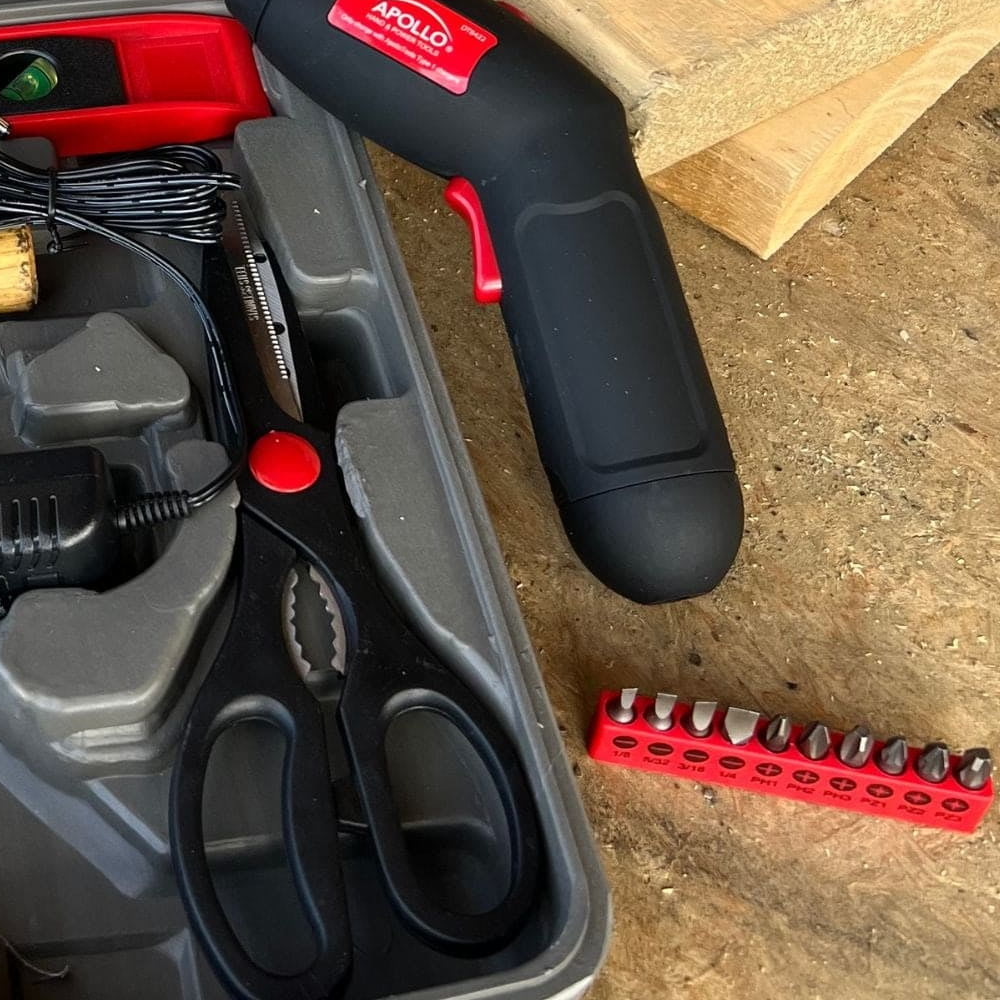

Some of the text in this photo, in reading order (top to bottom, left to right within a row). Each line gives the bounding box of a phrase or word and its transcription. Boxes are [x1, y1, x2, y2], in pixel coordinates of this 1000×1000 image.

[365, 13, 386, 27] HAND
[390, 26, 417, 45] POWER
[416, 40, 440, 57] TOOLS
[371, 1, 448, 47] APOLLO
